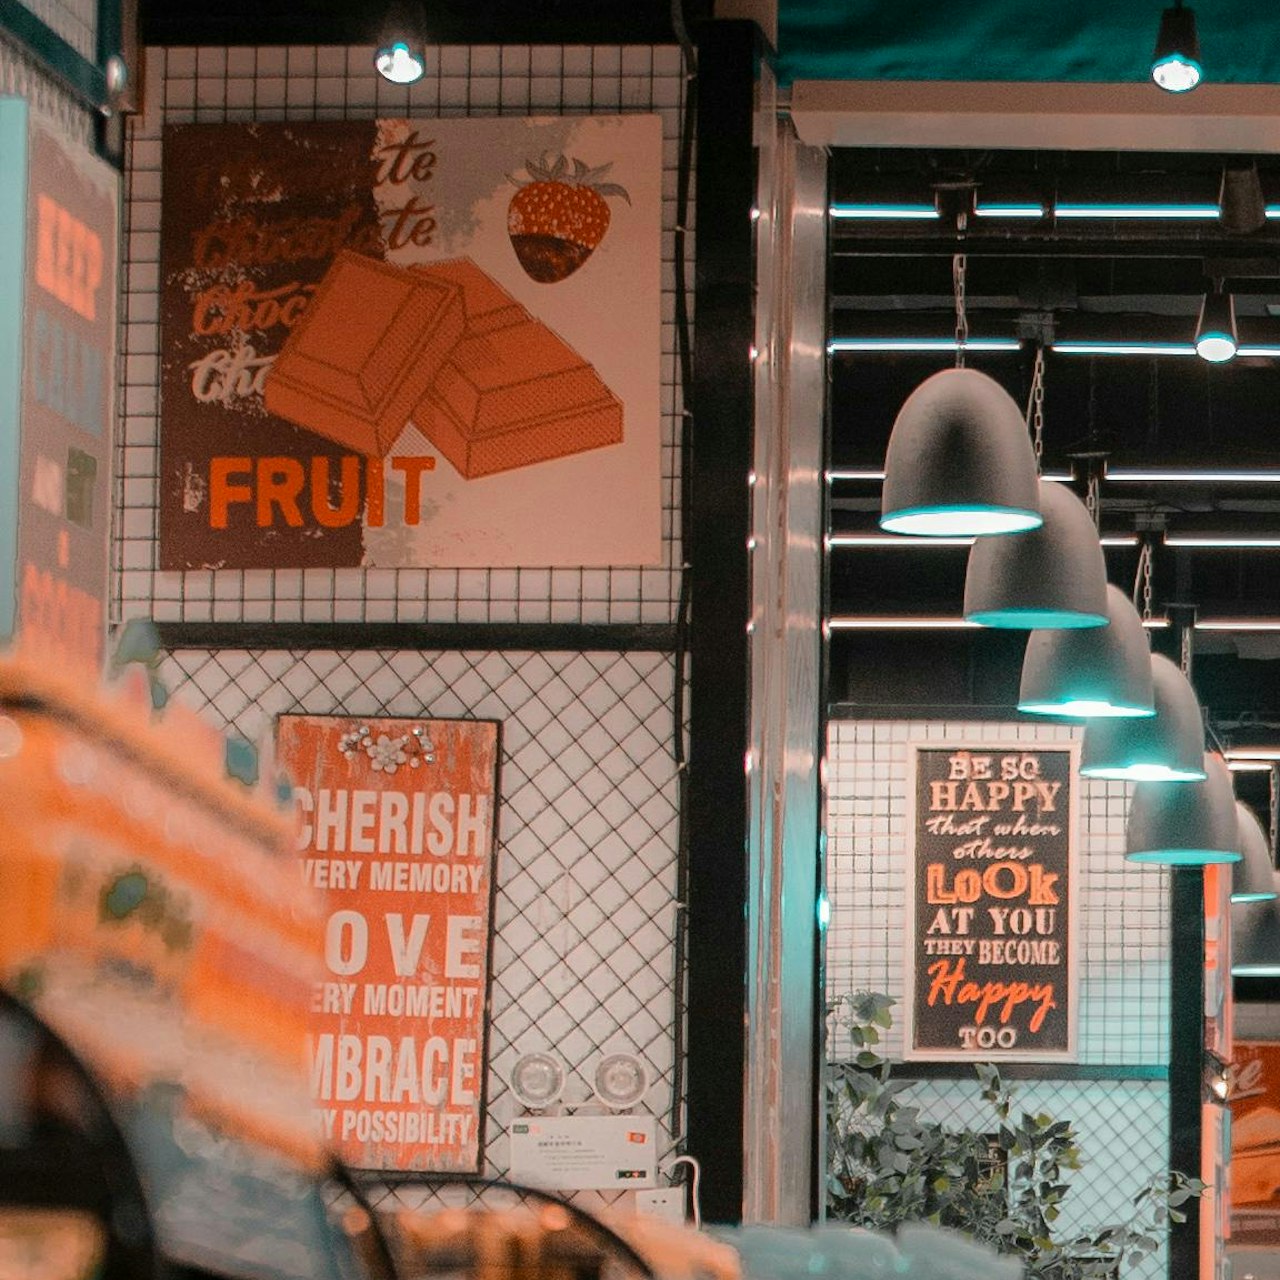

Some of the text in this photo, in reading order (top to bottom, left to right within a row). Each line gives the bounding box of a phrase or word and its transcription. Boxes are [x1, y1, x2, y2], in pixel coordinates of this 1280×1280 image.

[209, 456, 436, 528] FRUIT
[949, 757, 1039, 780] BE SO
[930, 781, 1061, 812] HAPPY
[293, 788, 487, 857] CHERISH
[926, 815, 1060, 836] that when
[953, 840, 1032, 860] others
[301, 859, 484, 894] VERY MEMORY
[926, 908, 1056, 935] AT YOU
[325, 910, 482, 979] OVE
[924, 940, 1060, 965] THEY BECOME
[363, 984, 477, 1018] MOMENT
[927, 957, 1056, 1033] Happy
[959, 1026, 1016, 1048] TOO
[308, 1032, 477, 1105] MBRACE
[341, 1109, 473, 1145] POSSIBILITY
